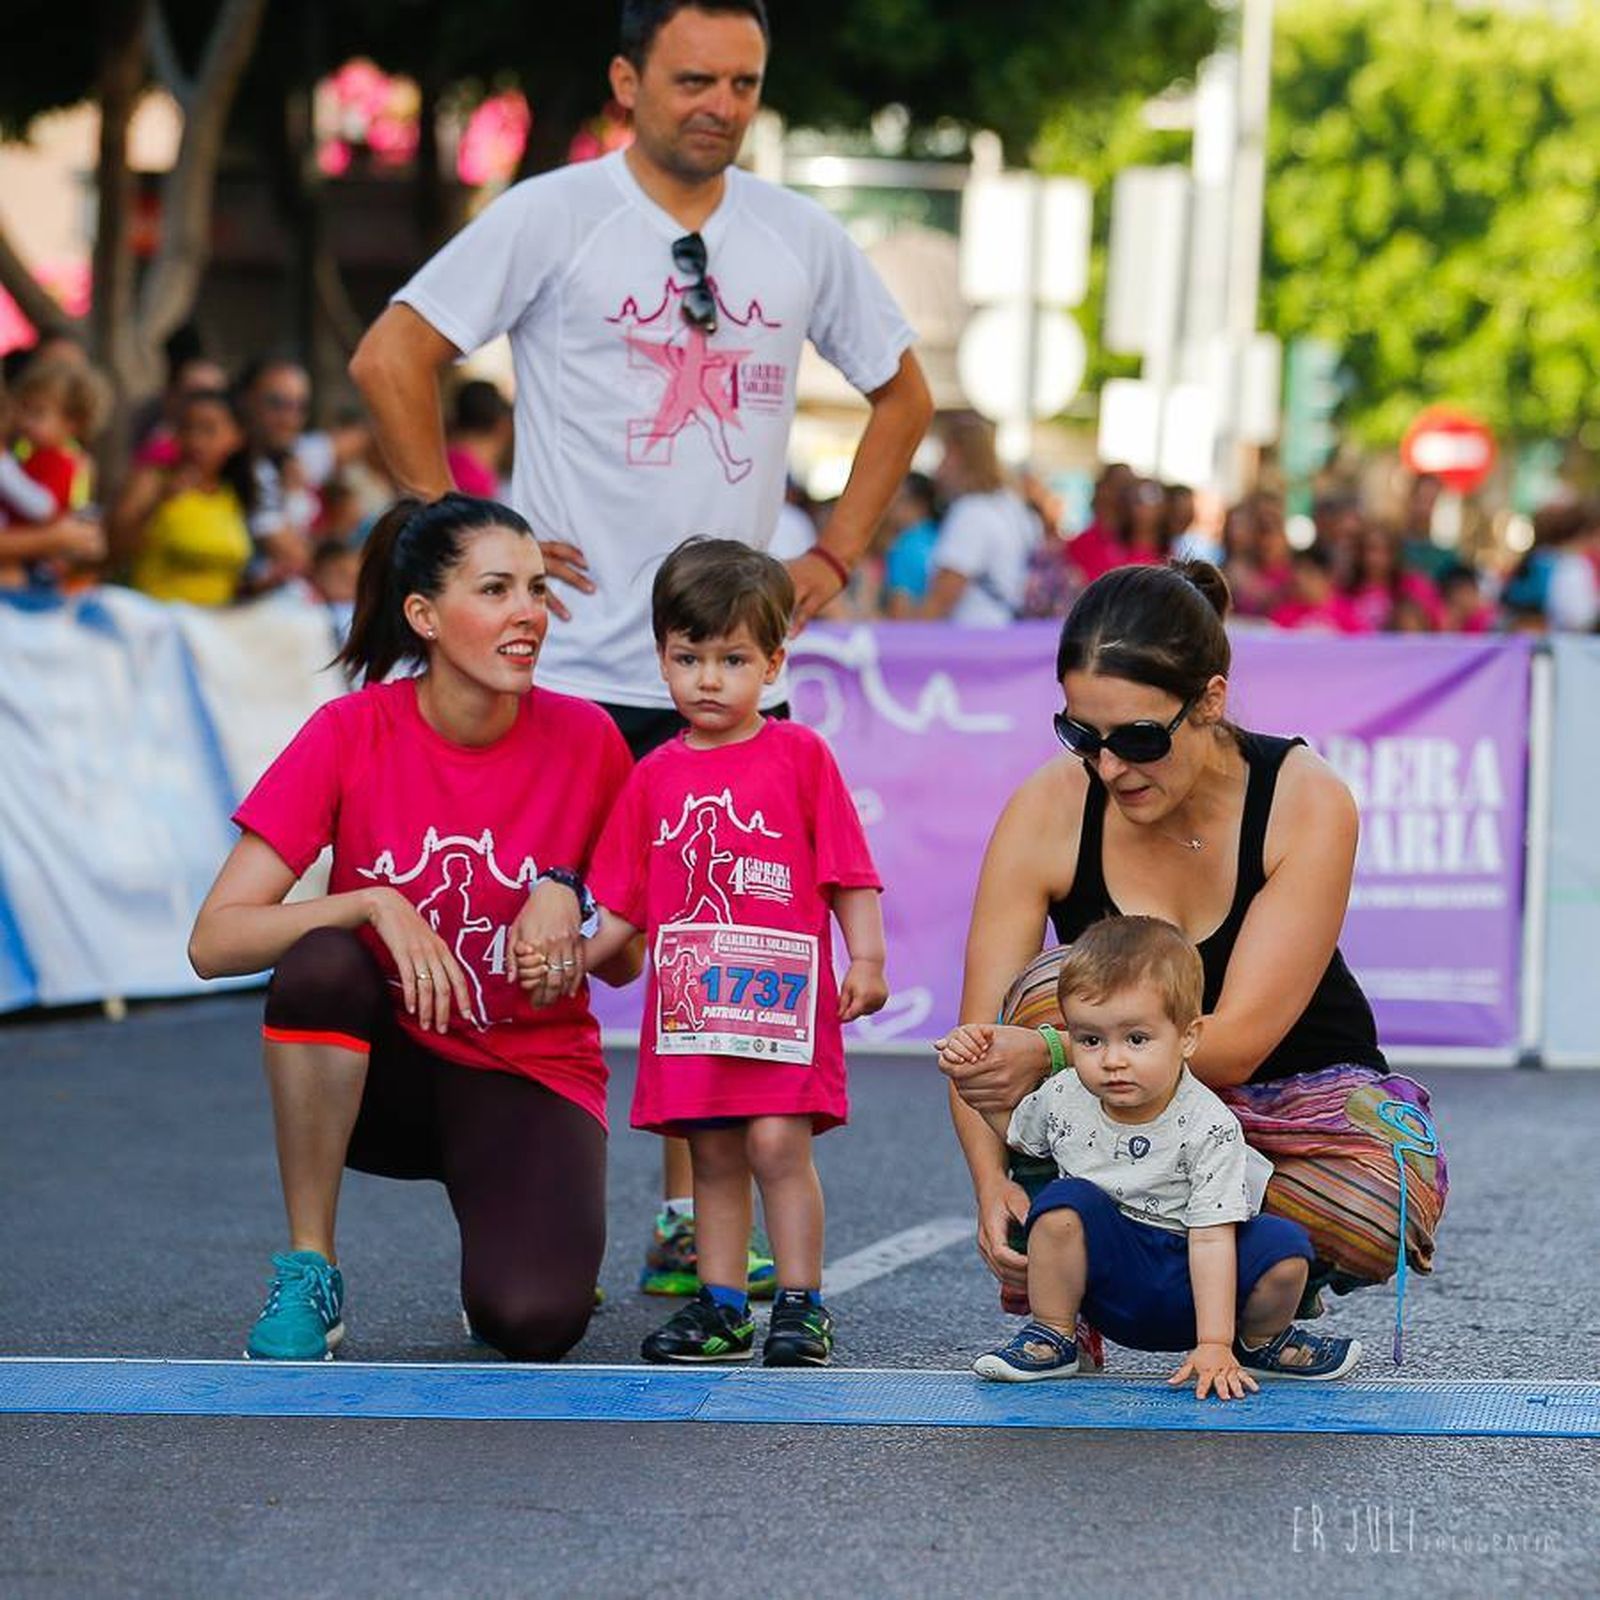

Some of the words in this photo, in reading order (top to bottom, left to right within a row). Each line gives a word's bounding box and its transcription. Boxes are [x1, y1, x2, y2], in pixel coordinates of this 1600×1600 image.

[1327, 735, 1504, 808] RERA
[1362, 811, 1503, 873] ARIA
[727, 856, 746, 895] 4
[482, 924, 506, 974] 4
[701, 965, 808, 1010] 1737
[701, 1005, 753, 1021] PATRULLA
[757, 1011, 797, 1026] CANINA
